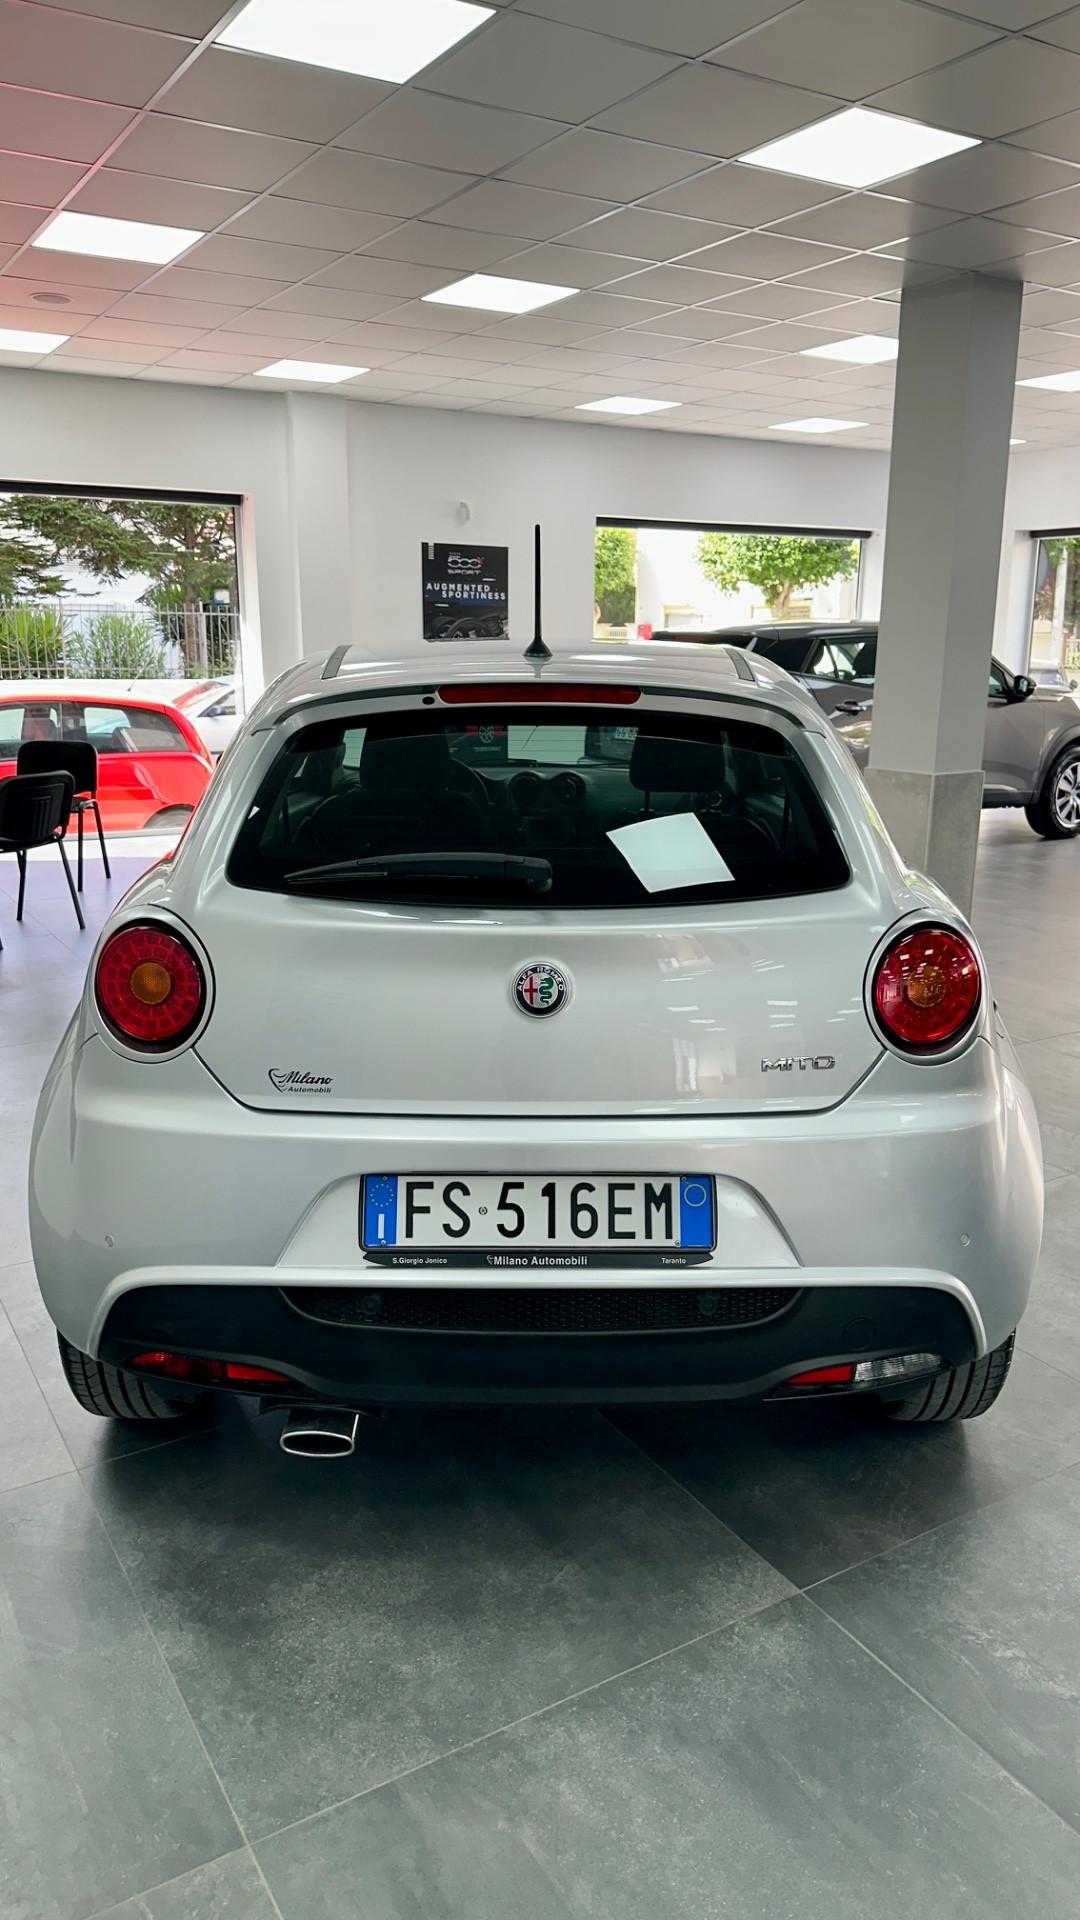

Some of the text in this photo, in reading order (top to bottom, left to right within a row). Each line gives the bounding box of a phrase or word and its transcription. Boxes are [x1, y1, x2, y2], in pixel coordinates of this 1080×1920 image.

[426, 582, 490, 592] AUGMENTED
[441, 590, 506, 600] SPORTINESS
[516, 969, 534, 992] ALFA
[761, 1056, 835, 1072] MITO
[278, 1070, 334, 1084] Milano
[405, 1181, 471, 1239] FS
[496, 1181, 673, 1240] 516EM
[493, 1256, 588, 1265] Milano Automobili
